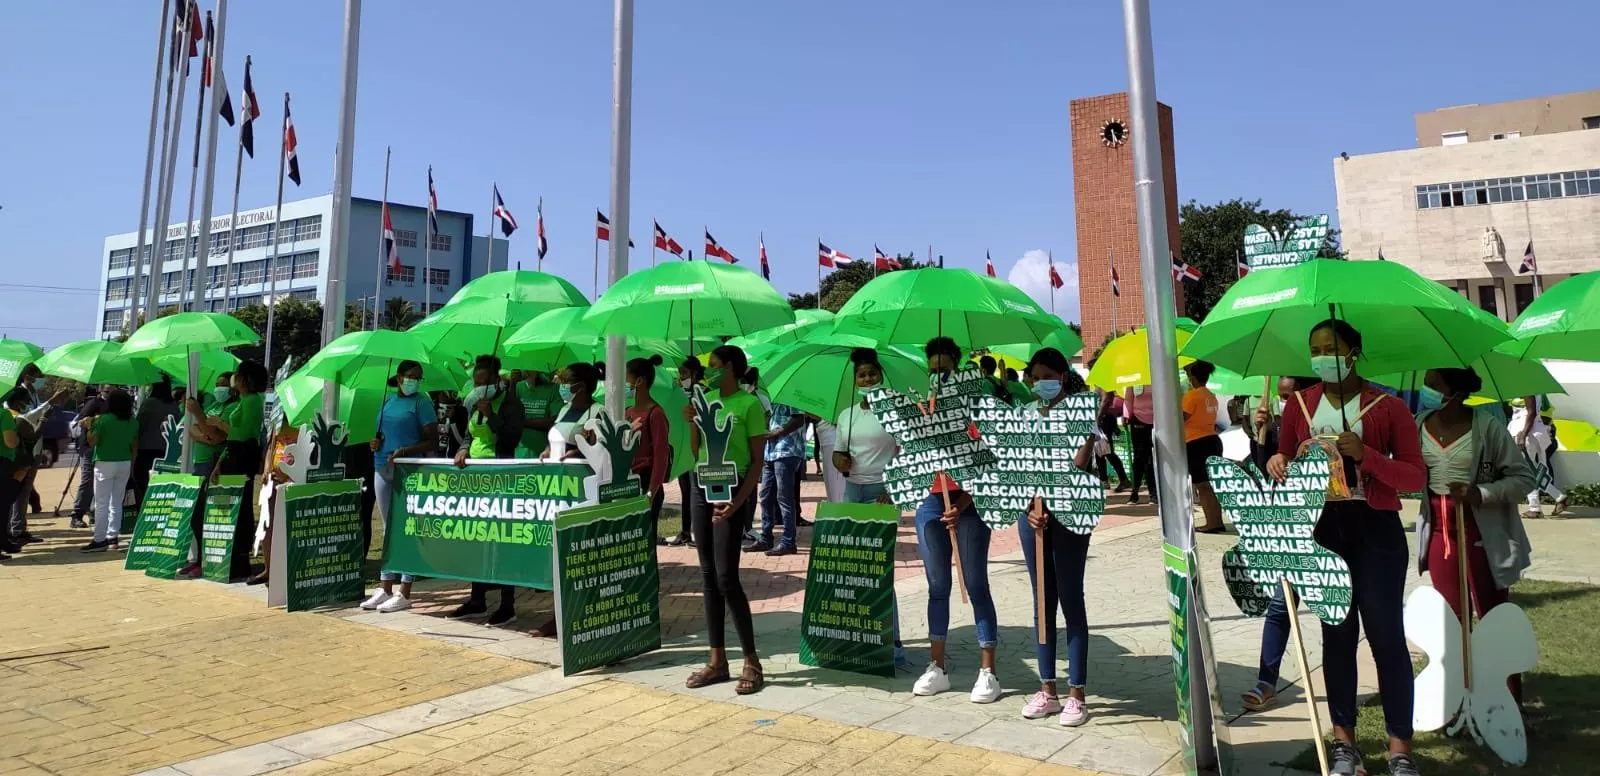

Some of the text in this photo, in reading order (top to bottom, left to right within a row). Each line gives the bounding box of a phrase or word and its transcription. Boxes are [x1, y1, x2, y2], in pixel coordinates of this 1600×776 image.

[235, 210, 274, 225] LECTORAL
[405, 472, 578, 498] #LASCAUSALESVAN
[571, 543, 578, 551] SI
[581, 539, 594, 549] UNA
[597, 534, 613, 546] NIÑA
[622, 528, 643, 540] MUJER
[821, 534, 825, 544] SI
[840, 533, 854, 545] NIÑA
[862, 537, 882, 548] MUJER
[566, 539, 649, 566] TIENE UN EMBARAZO QUE
[815, 547, 887, 561] TIENE UN EMBARAZO QUE
[566, 567, 585, 579] PONE
[587, 565, 596, 574] EN
[600, 558, 622, 571] RIESGO
[624, 556, 632, 566] SU
[813, 560, 826, 569] PONE
[828, 561, 835, 570] EN
[838, 562, 858, 572] RIESGO
[860, 564, 868, 573] SU
[574, 580, 583, 591] LA
[585, 577, 597, 588] LEY
[600, 575, 608, 584] LA
[610, 568, 639, 583] CONDENA
[816, 573, 879, 588] LA LEY LA CONDENA A
[585, 593, 638, 614] ES HORA DE QUE
[822, 600, 870, 615] ES HORA DE QUE
[573, 603, 650, 631] EL CÓDIGO PENAL LE DE
[810, 612, 882, 631] EL CÓDIGO PENAL LE DE
[572, 624, 620, 644] OPORTUNIDAD
[623, 621, 631, 630] DE
[808, 625, 883, 645] OPORTUNIDAD DE VIVIR.
